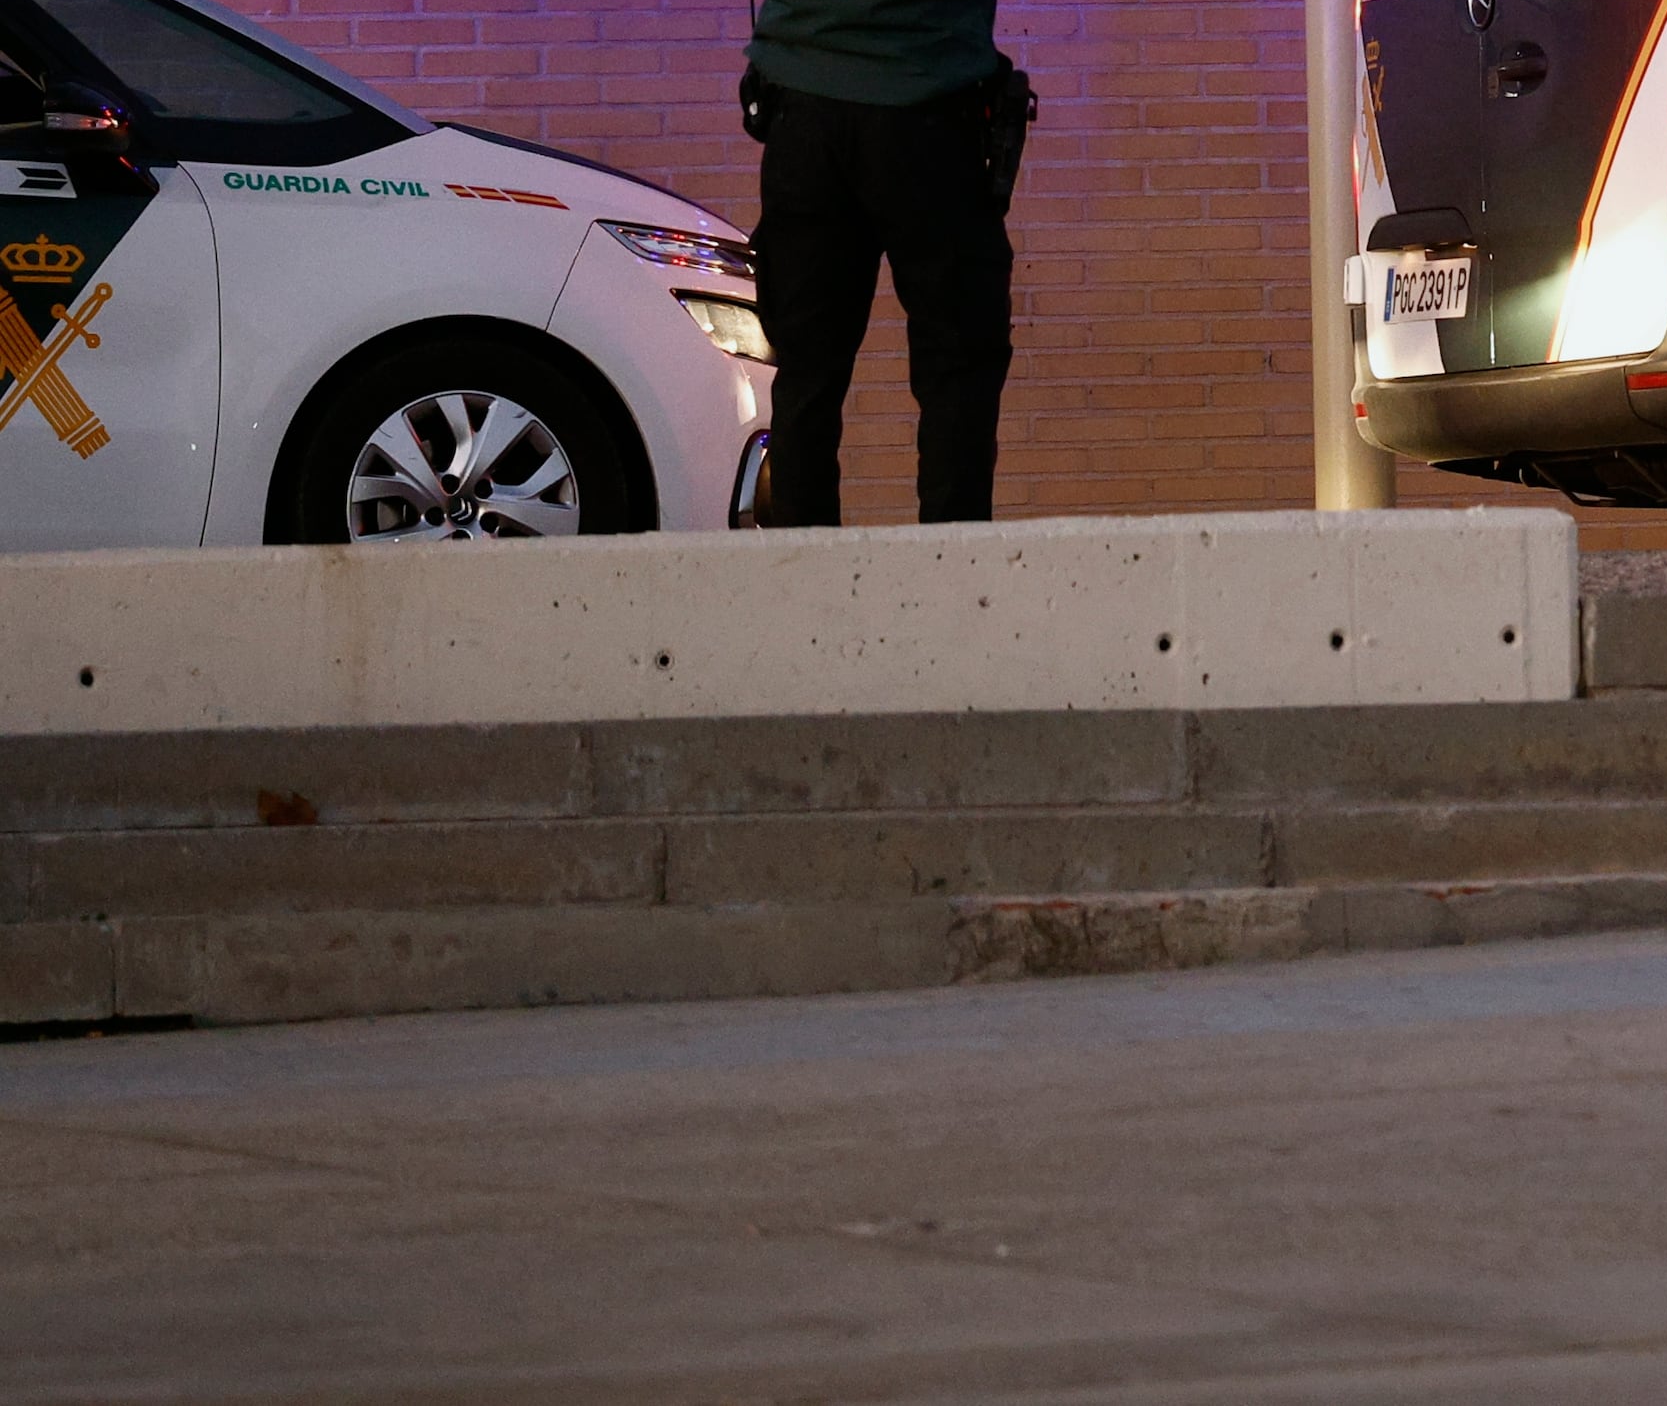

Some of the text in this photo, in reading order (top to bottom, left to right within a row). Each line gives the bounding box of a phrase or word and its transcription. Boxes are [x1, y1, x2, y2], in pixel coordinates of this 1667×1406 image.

[223, 172, 430, 197] GUARDIA CIVIL
[1393, 272, 1416, 314] PGC
